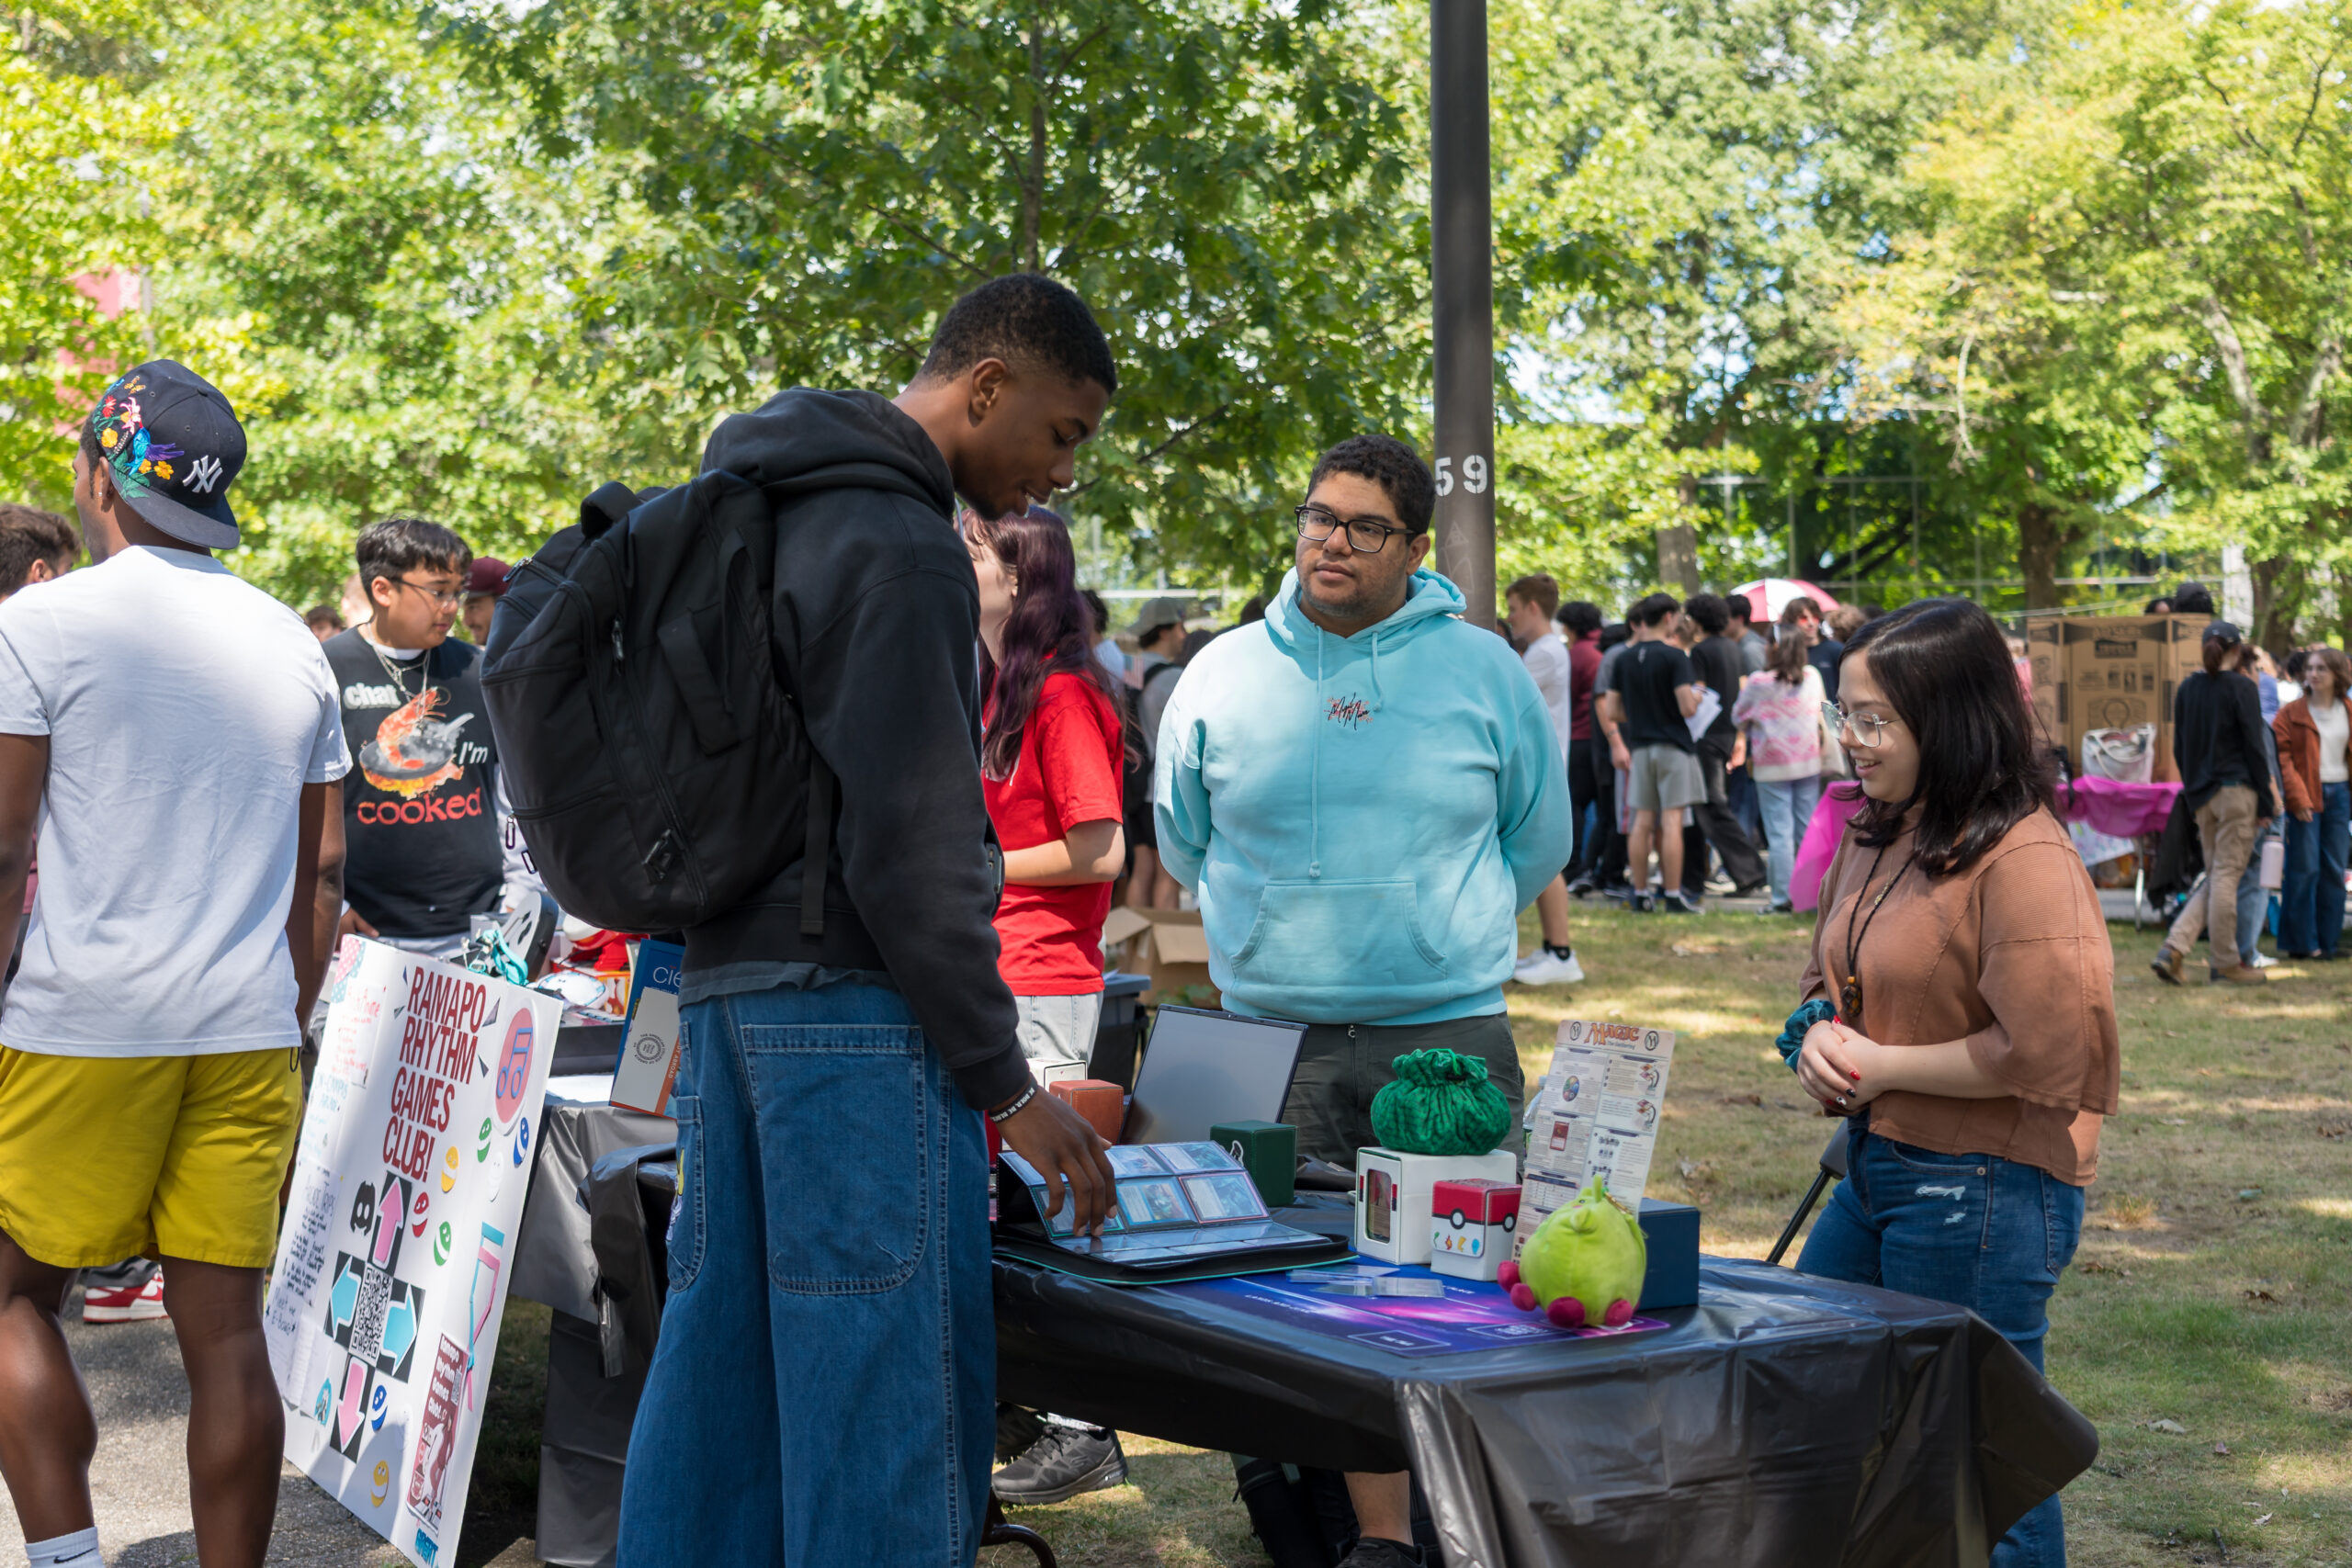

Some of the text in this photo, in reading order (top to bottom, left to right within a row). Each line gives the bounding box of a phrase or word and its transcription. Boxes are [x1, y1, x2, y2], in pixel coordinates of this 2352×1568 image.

[182, 455, 223, 493] NY
[1435, 455, 1487, 497] 59
[458, 741, 489, 764] I'm
[357, 787, 482, 825] cooked
[407, 966, 486, 1033] RAMAPO
[399, 1016, 478, 1085] RHYTHM
[391, 1066, 455, 1133] GAMES
[382, 1115, 435, 1183] CLUB!
